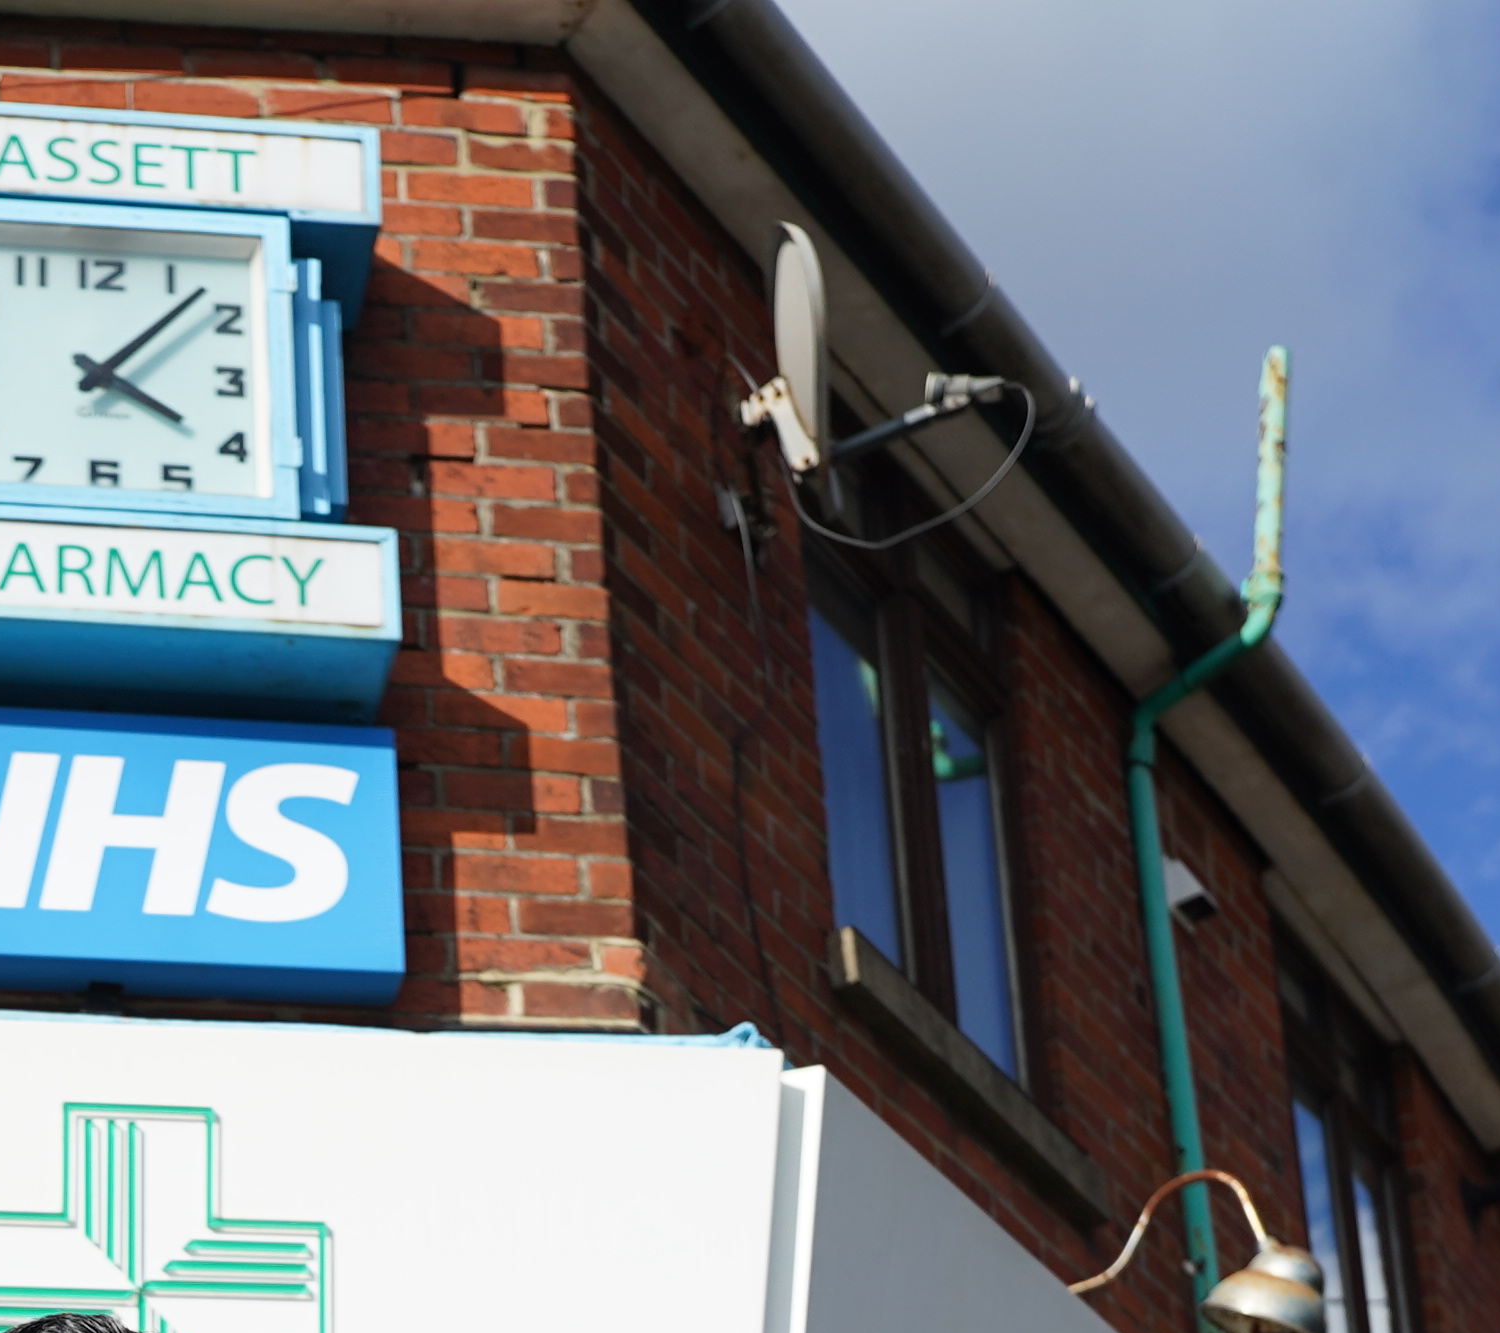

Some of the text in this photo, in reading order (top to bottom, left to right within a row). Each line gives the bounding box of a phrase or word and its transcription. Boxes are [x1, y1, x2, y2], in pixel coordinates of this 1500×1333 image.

[79, 259, 125, 291] 12
[168, 264, 176, 294] 1
[215, 304, 243, 335] 2
[217, 367, 245, 398] 3
[219, 432, 247, 462] 4
[15, 456, 44, 481] 7
[91, 460, 119, 486] 6
[163, 464, 192, 490] 5
